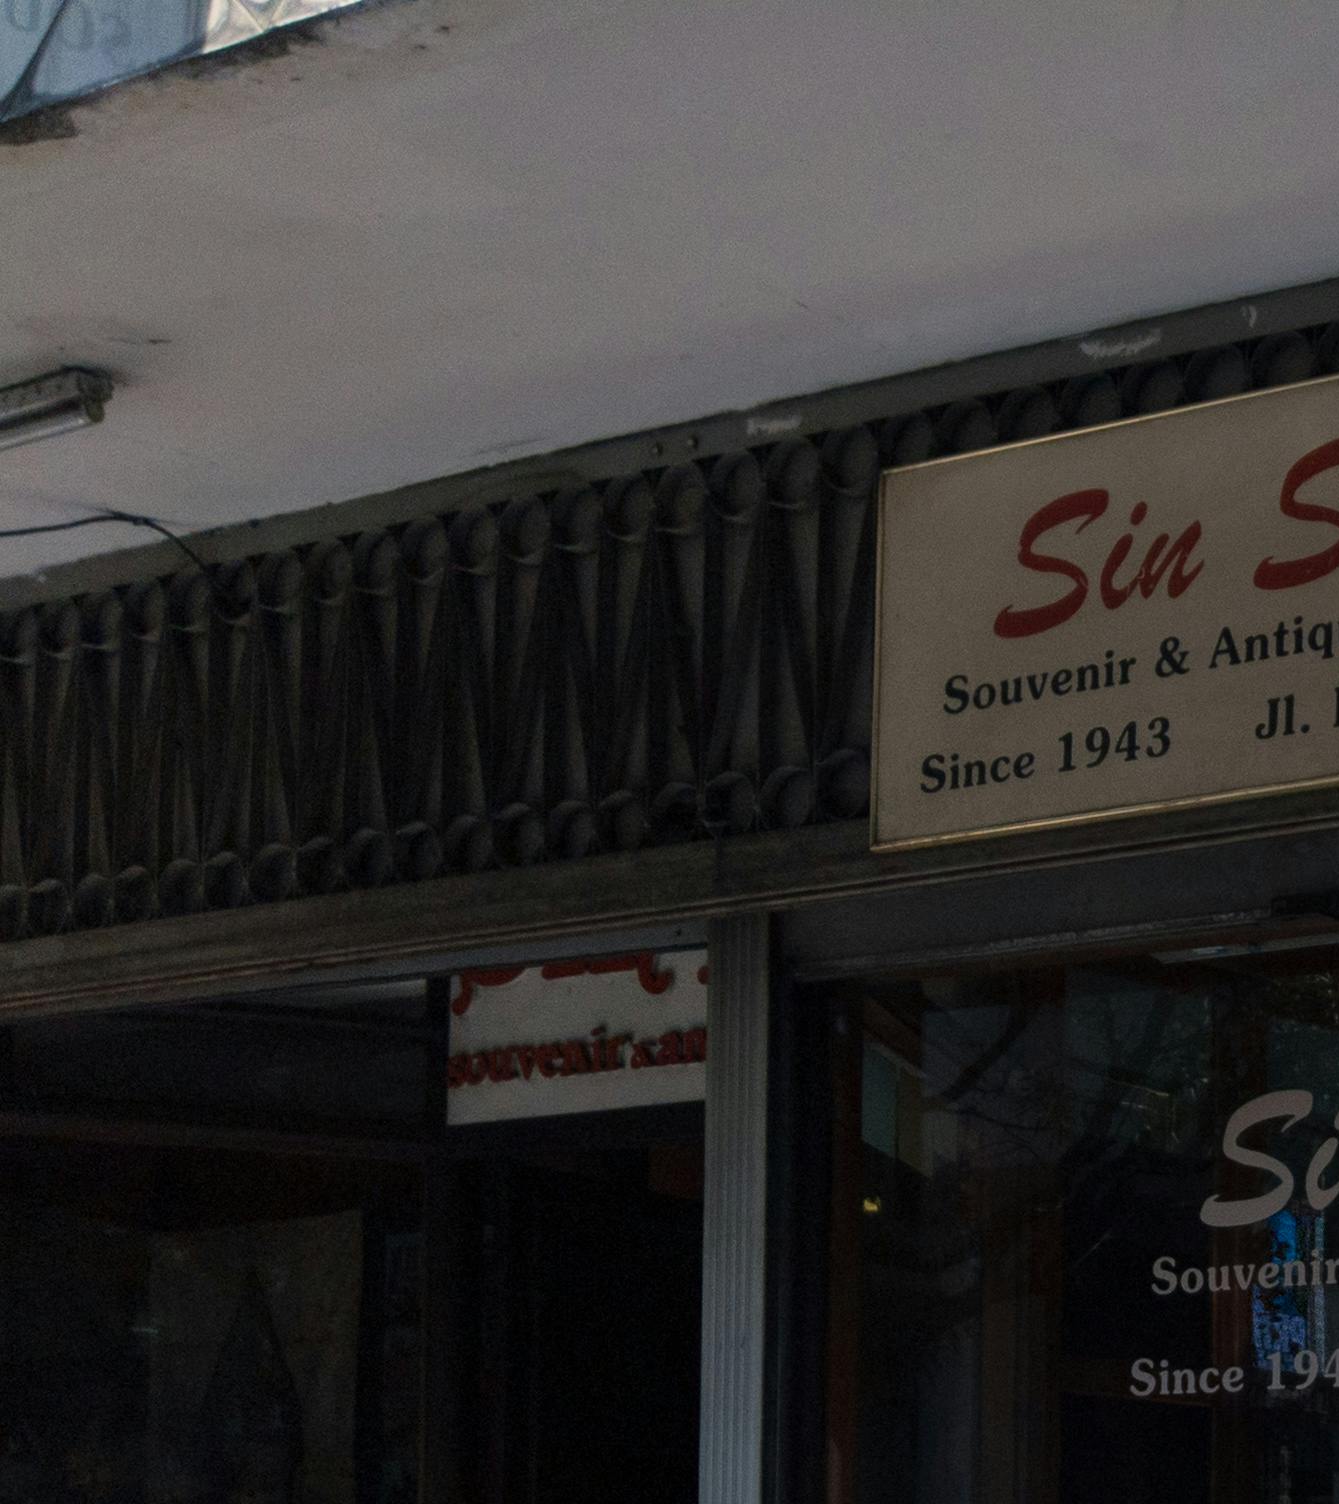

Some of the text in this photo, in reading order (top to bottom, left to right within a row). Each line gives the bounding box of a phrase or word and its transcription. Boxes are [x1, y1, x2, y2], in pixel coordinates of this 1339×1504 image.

[993, 488, 1205, 639] Sin
[942, 649, 1138, 715] Souvenir
[1154, 635, 1191, 677] &
[919, 716, 1172, 795] Since 1943
[1129, 1358, 1245, 1397] Since
